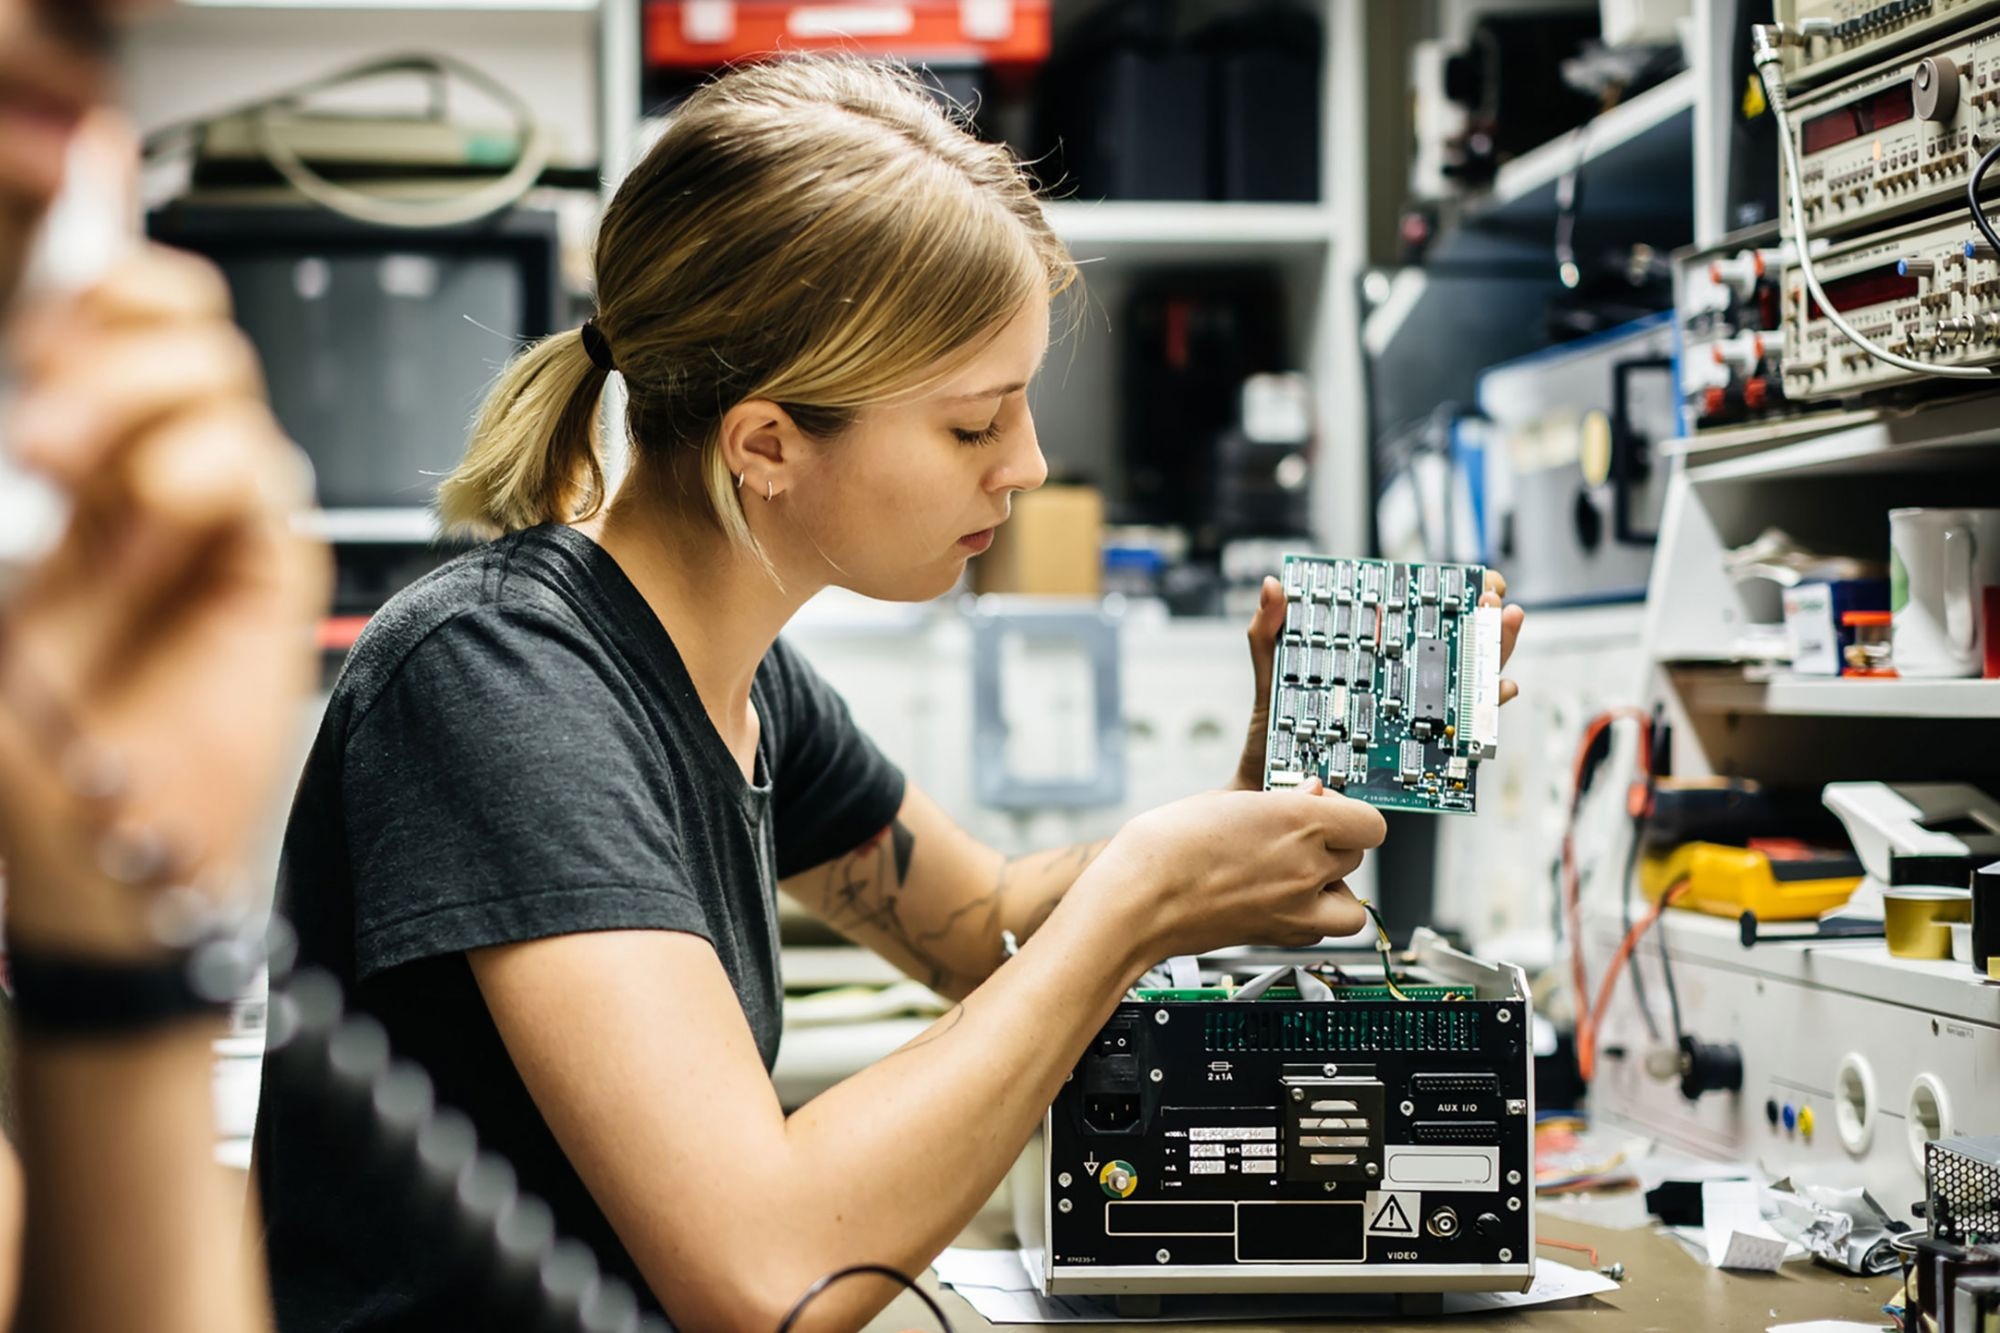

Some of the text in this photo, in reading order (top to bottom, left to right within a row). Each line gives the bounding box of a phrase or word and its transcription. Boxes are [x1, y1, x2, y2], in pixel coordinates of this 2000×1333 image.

[1437, 1103, 1478, 1112] AUX I/O
[1386, 1251, 1418, 1260] VIDEO
